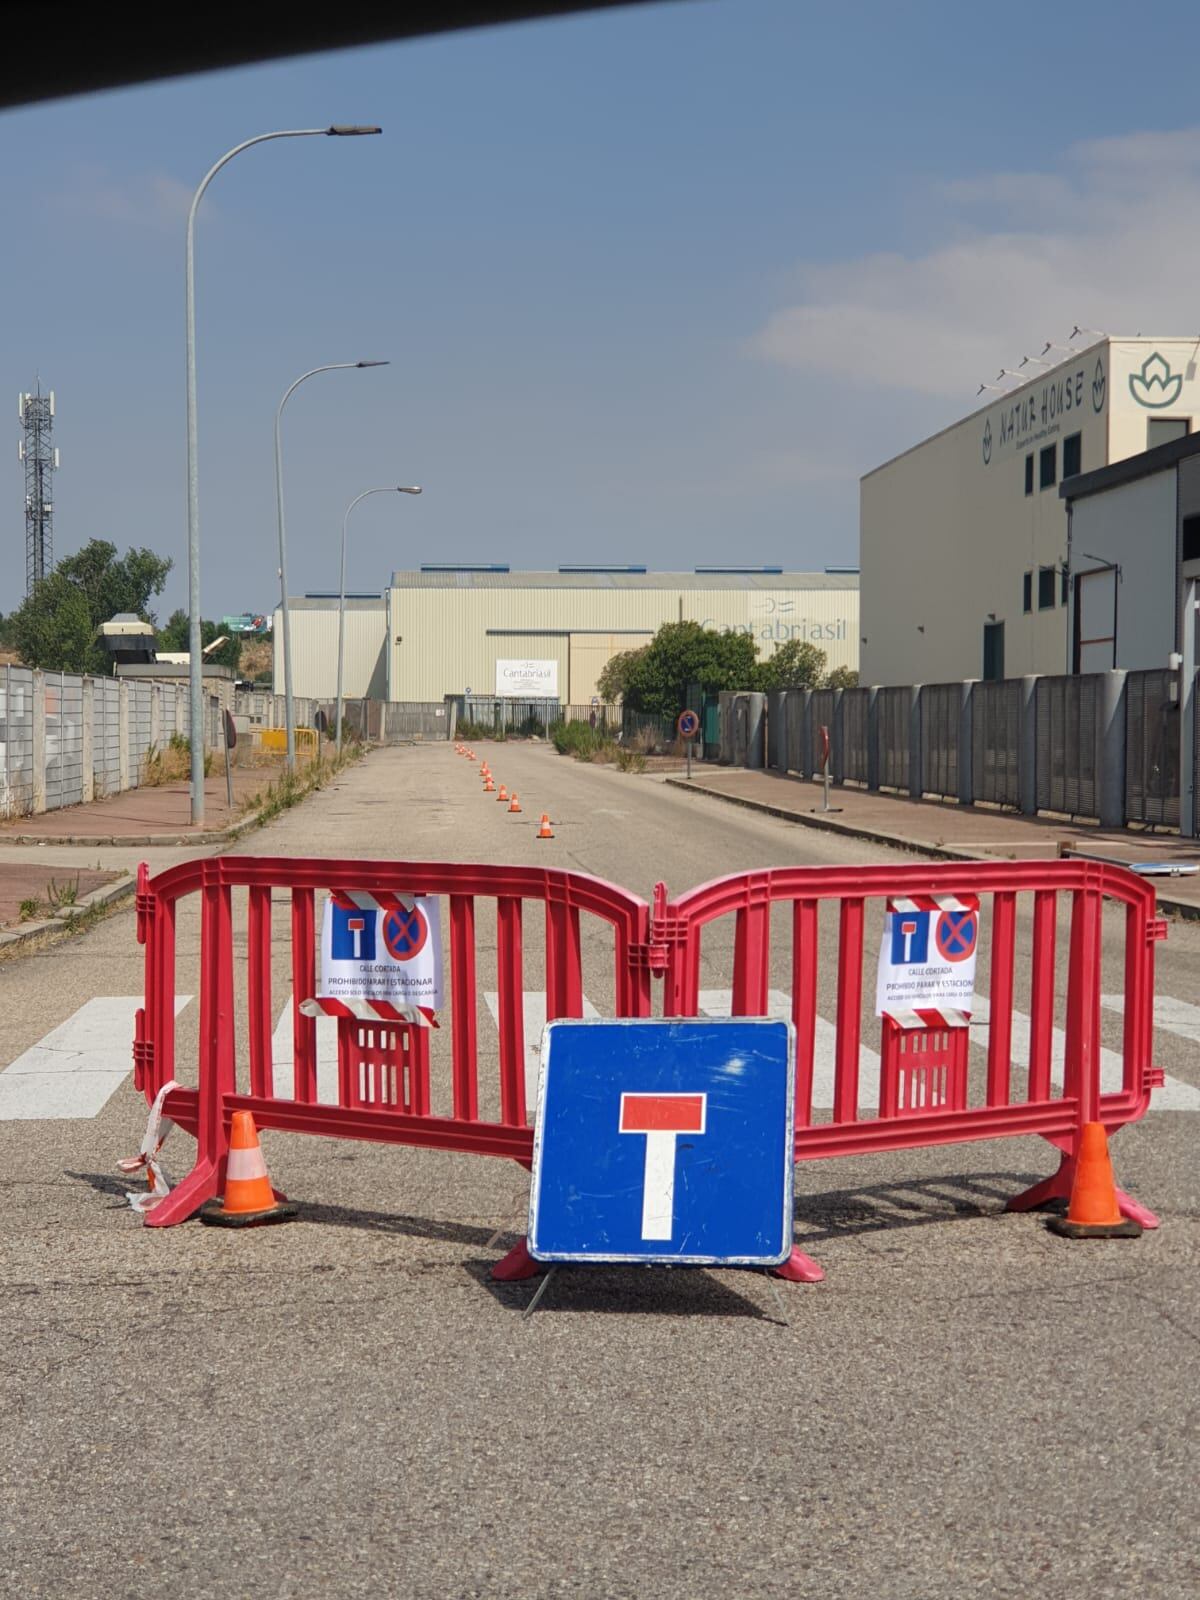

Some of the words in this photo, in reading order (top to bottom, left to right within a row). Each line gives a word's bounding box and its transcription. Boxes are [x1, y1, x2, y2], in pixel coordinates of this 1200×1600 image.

[1000, 395, 1036, 448] NATUR
[1041, 370, 1084, 424] HOUSE
[701, 618, 846, 640] Cantabriasil
[503, 667, 551, 678] Cantabriasil
[374, 964, 401, 973] CORTADA
[925, 967, 953, 976] CORTADA
